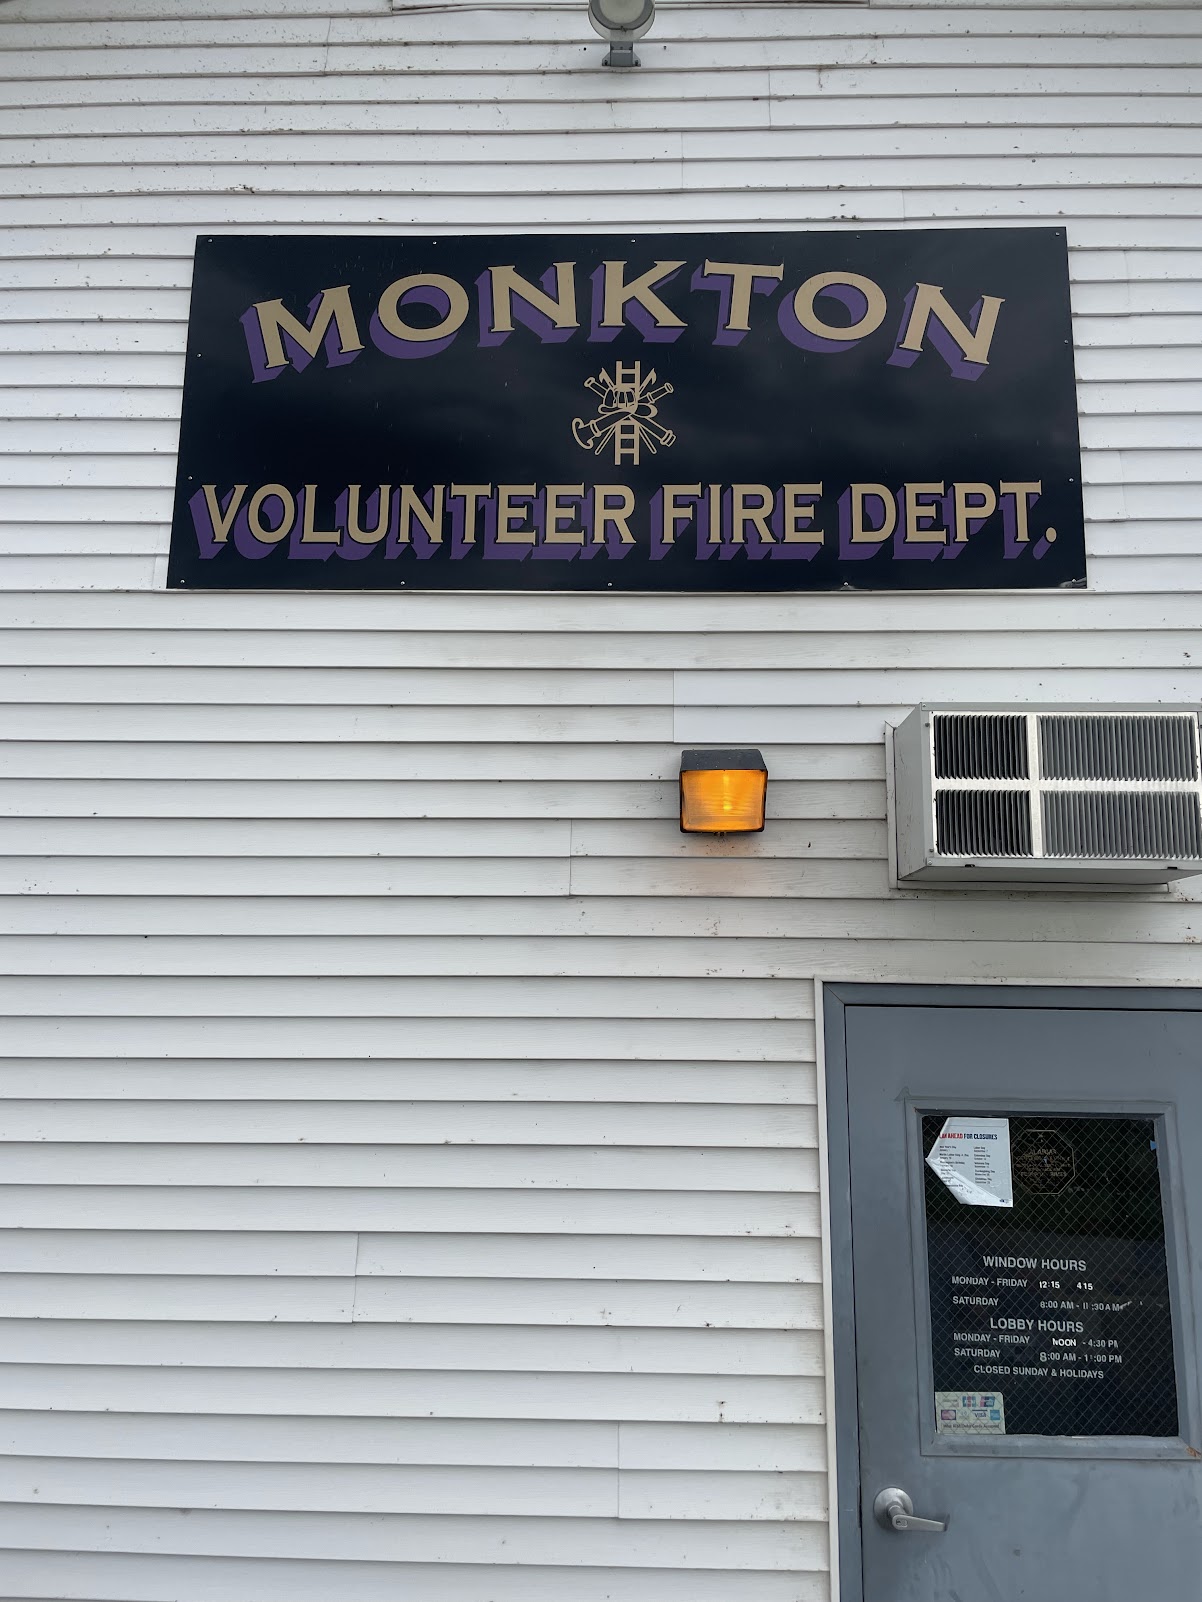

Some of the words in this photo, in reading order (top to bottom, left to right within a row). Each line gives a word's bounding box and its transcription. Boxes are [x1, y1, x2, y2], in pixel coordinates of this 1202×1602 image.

[247, 259, 1005, 375] MONKTON
[198, 481, 637, 550] VOLUNTEER
[657, 480, 826, 550] FIRE
[846, 479, 1058, 550] DEPT.
[983, 1256, 1037, 1269] WINDOW
[1041, 1259, 1087, 1271] HOURS
[952, 1276, 989, 1285] MONDAY
[997, 1278, 1028, 1287] FRIDAY
[952, 1296, 999, 1306] SATURDAY
[1040, 1300, 1058, 1309] 8:00
[1060, 1301, 1074, 1309] AM
[990, 1318, 1034, 1330] LOBBY
[1038, 1320, 1083, 1332] HOURS
[953, 1332, 991, 1342] MONDAY
[999, 1335, 1030, 1343] FRIDAY
[1052, 1338, 1077, 1346] NOON
[954, 1348, 1000, 1358] SATURDAY
[1040, 1352, 1060, 1362] 8:00
[1109, 1355, 1122, 1363] PM
[974, 1365, 1010, 1374] CLOSED
[1012, 1367, 1048, 1376] SUNDAY
[1060, 1369, 1104, 1378] HOLIDAYS
